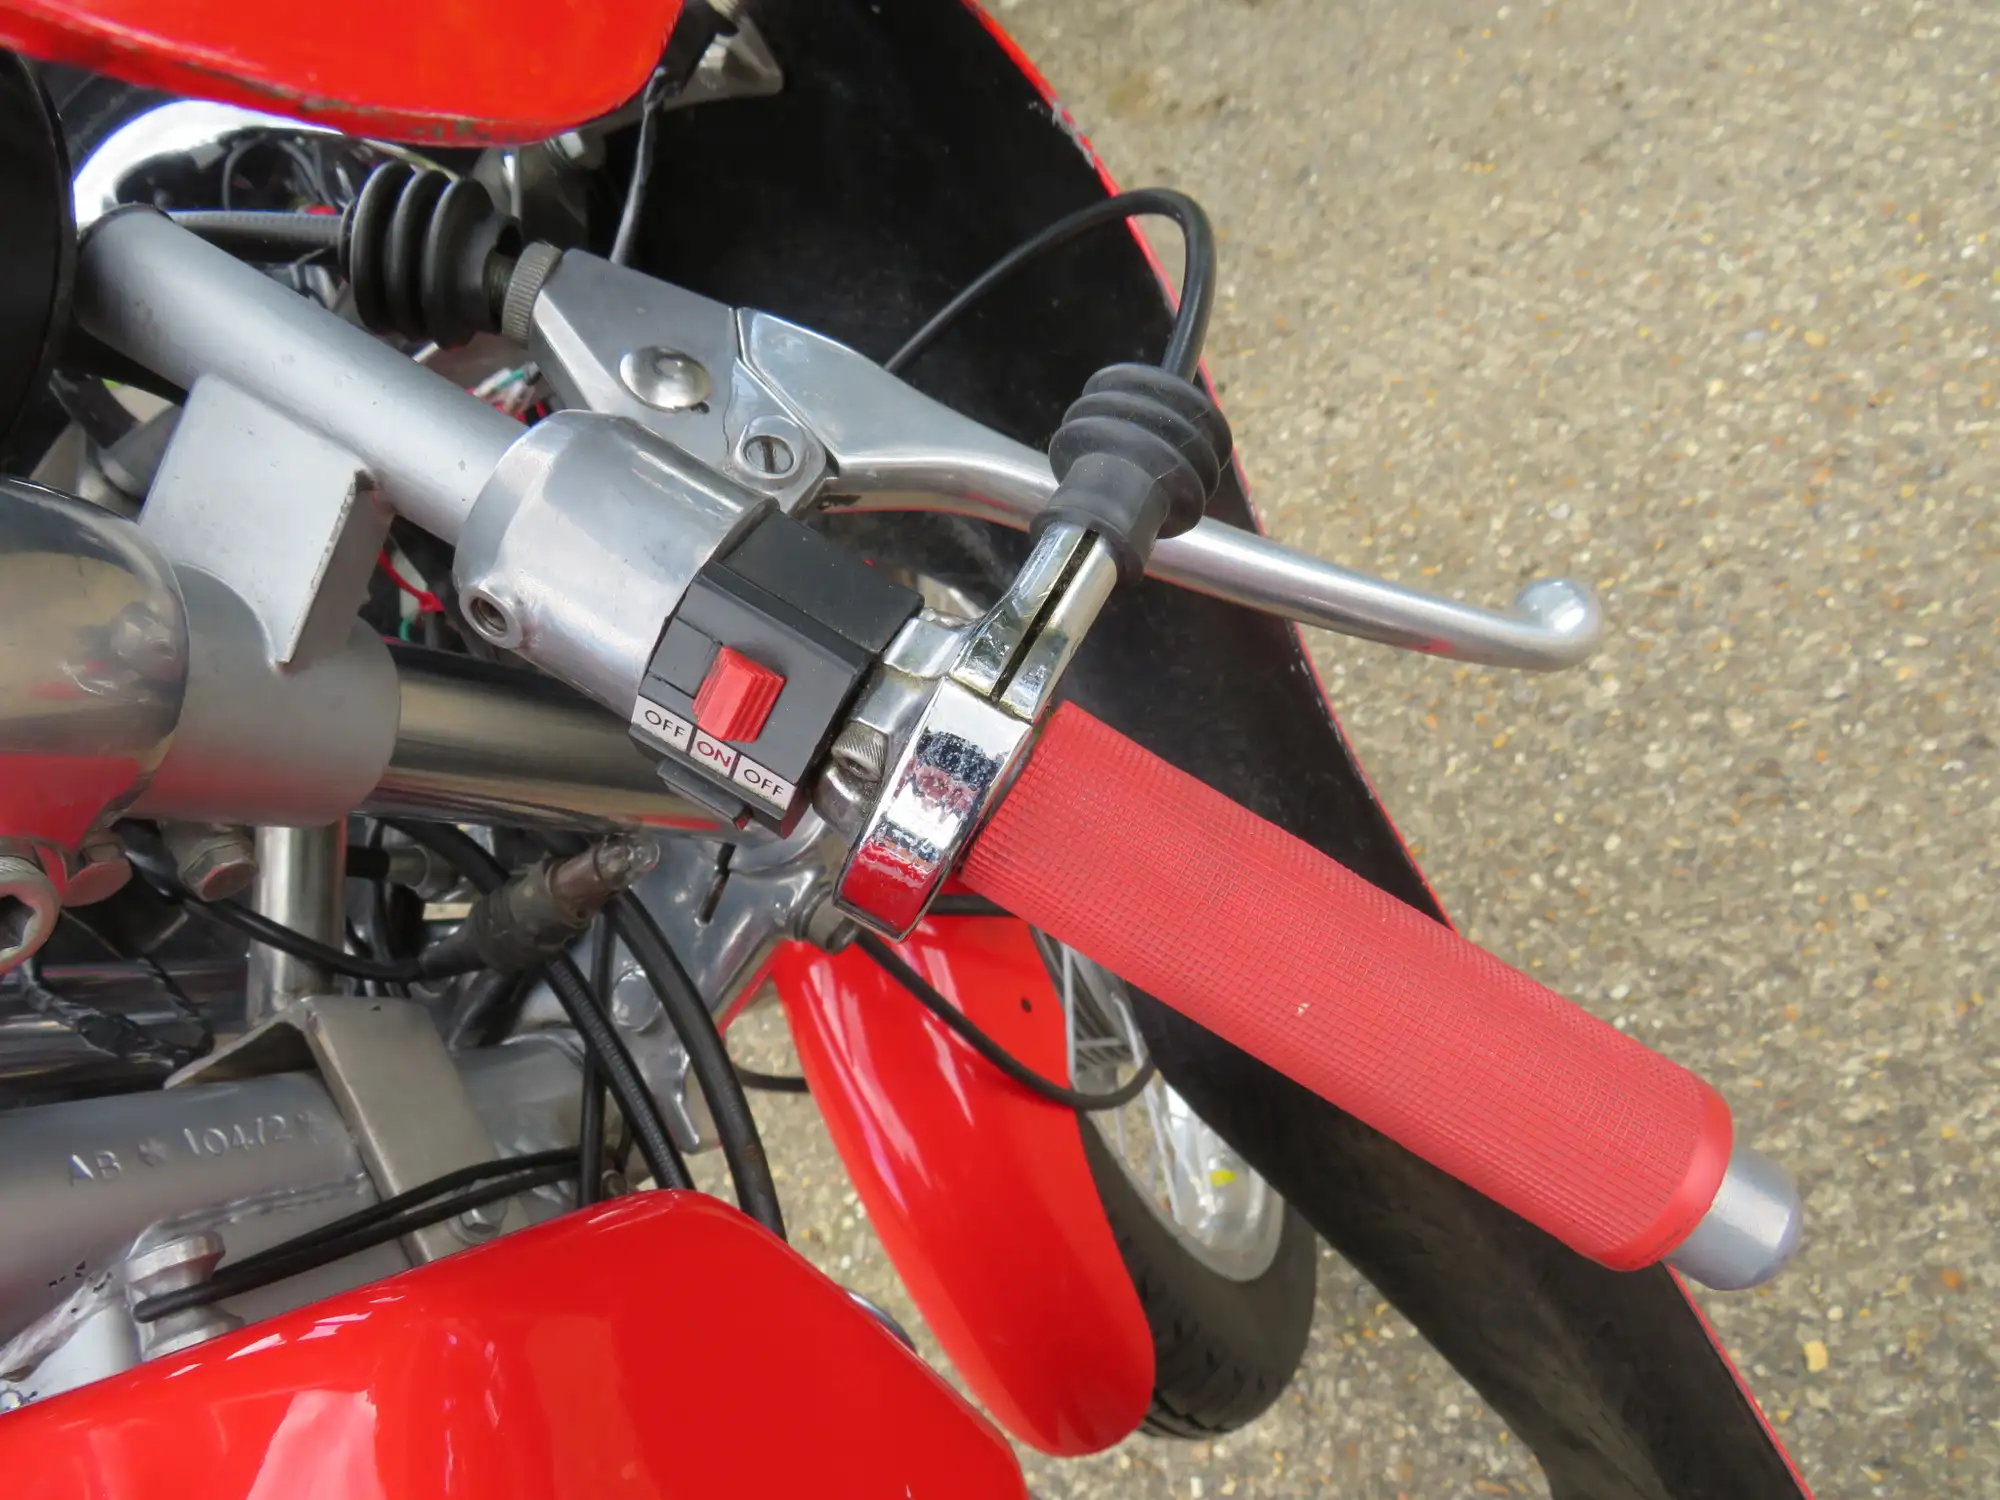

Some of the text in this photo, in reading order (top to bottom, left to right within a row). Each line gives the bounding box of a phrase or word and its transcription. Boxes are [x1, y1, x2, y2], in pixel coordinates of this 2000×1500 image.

[644, 710, 784, 796] OFF ON OFF
[69, 1150, 122, 1187] AB
